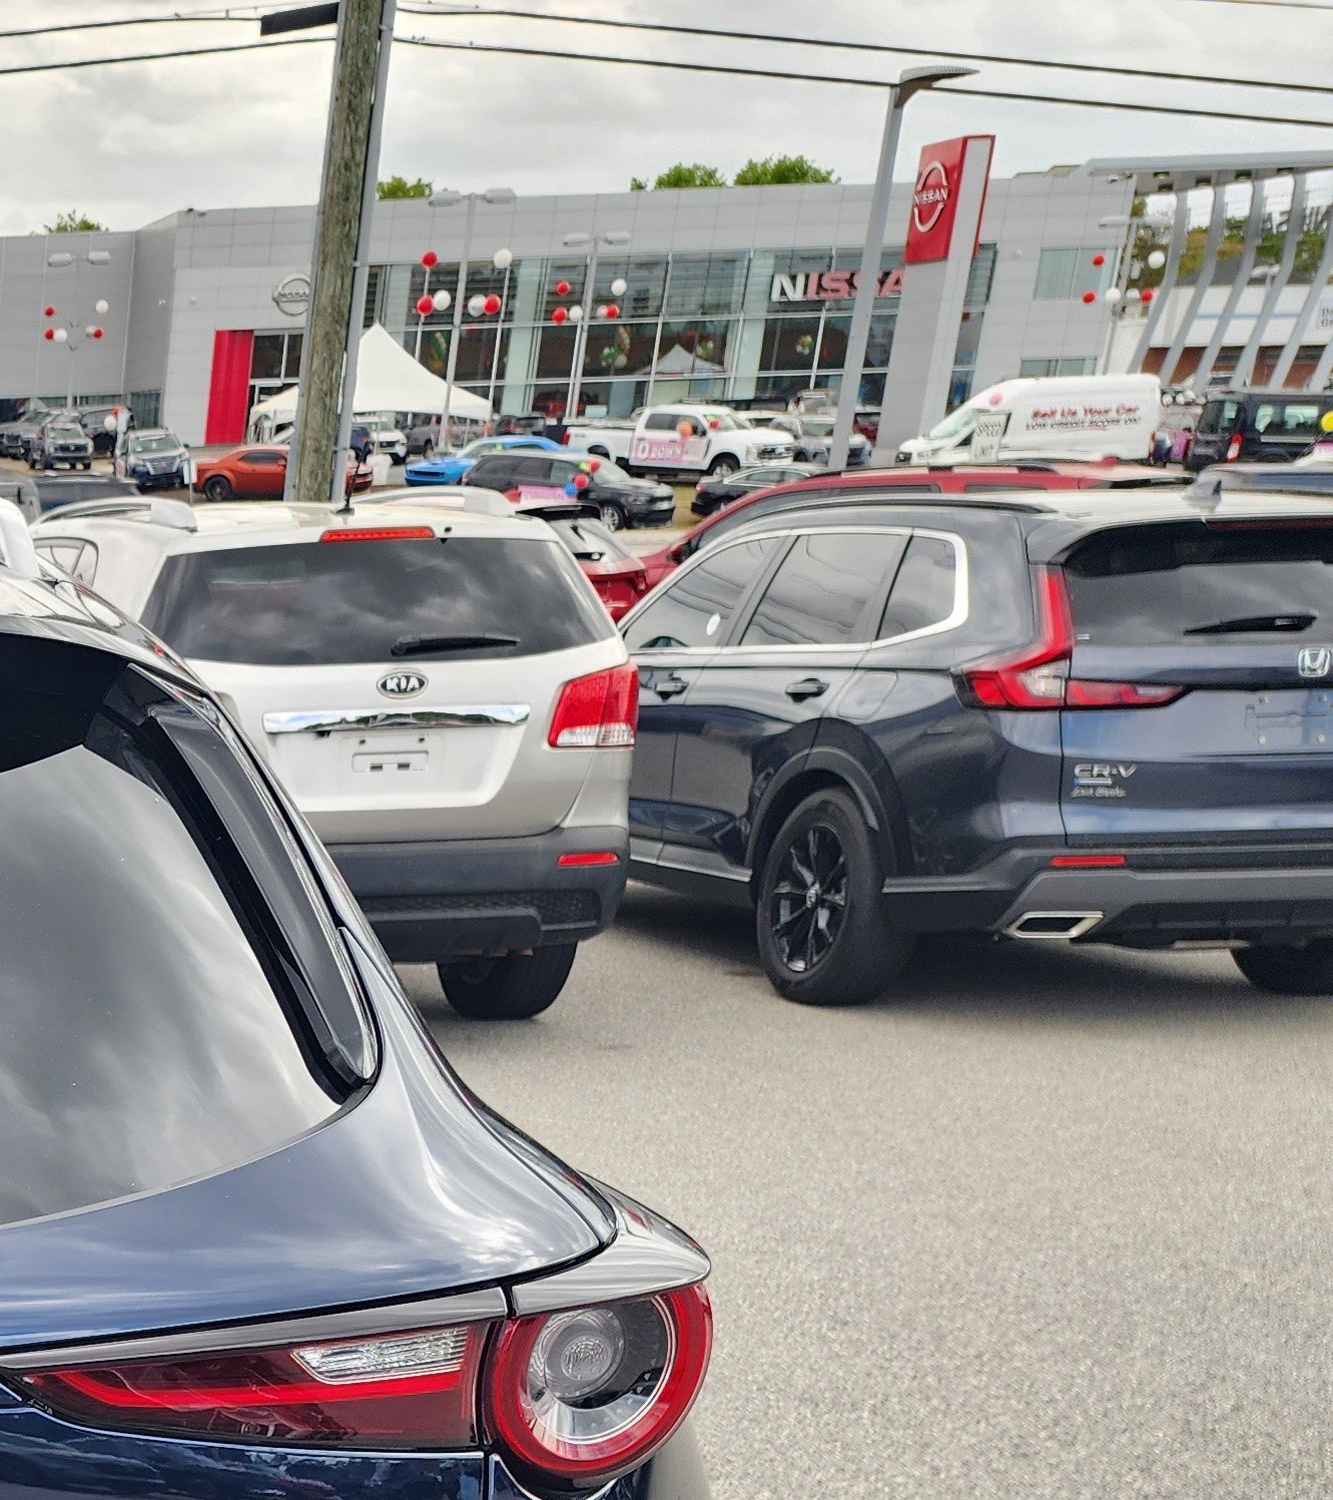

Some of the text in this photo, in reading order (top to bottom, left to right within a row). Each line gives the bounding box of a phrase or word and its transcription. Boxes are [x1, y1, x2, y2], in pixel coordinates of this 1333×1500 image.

[913, 187, 948, 205] NISSAN
[386, 675, 420, 692] KIA
[1074, 763, 1138, 778] CR-V
